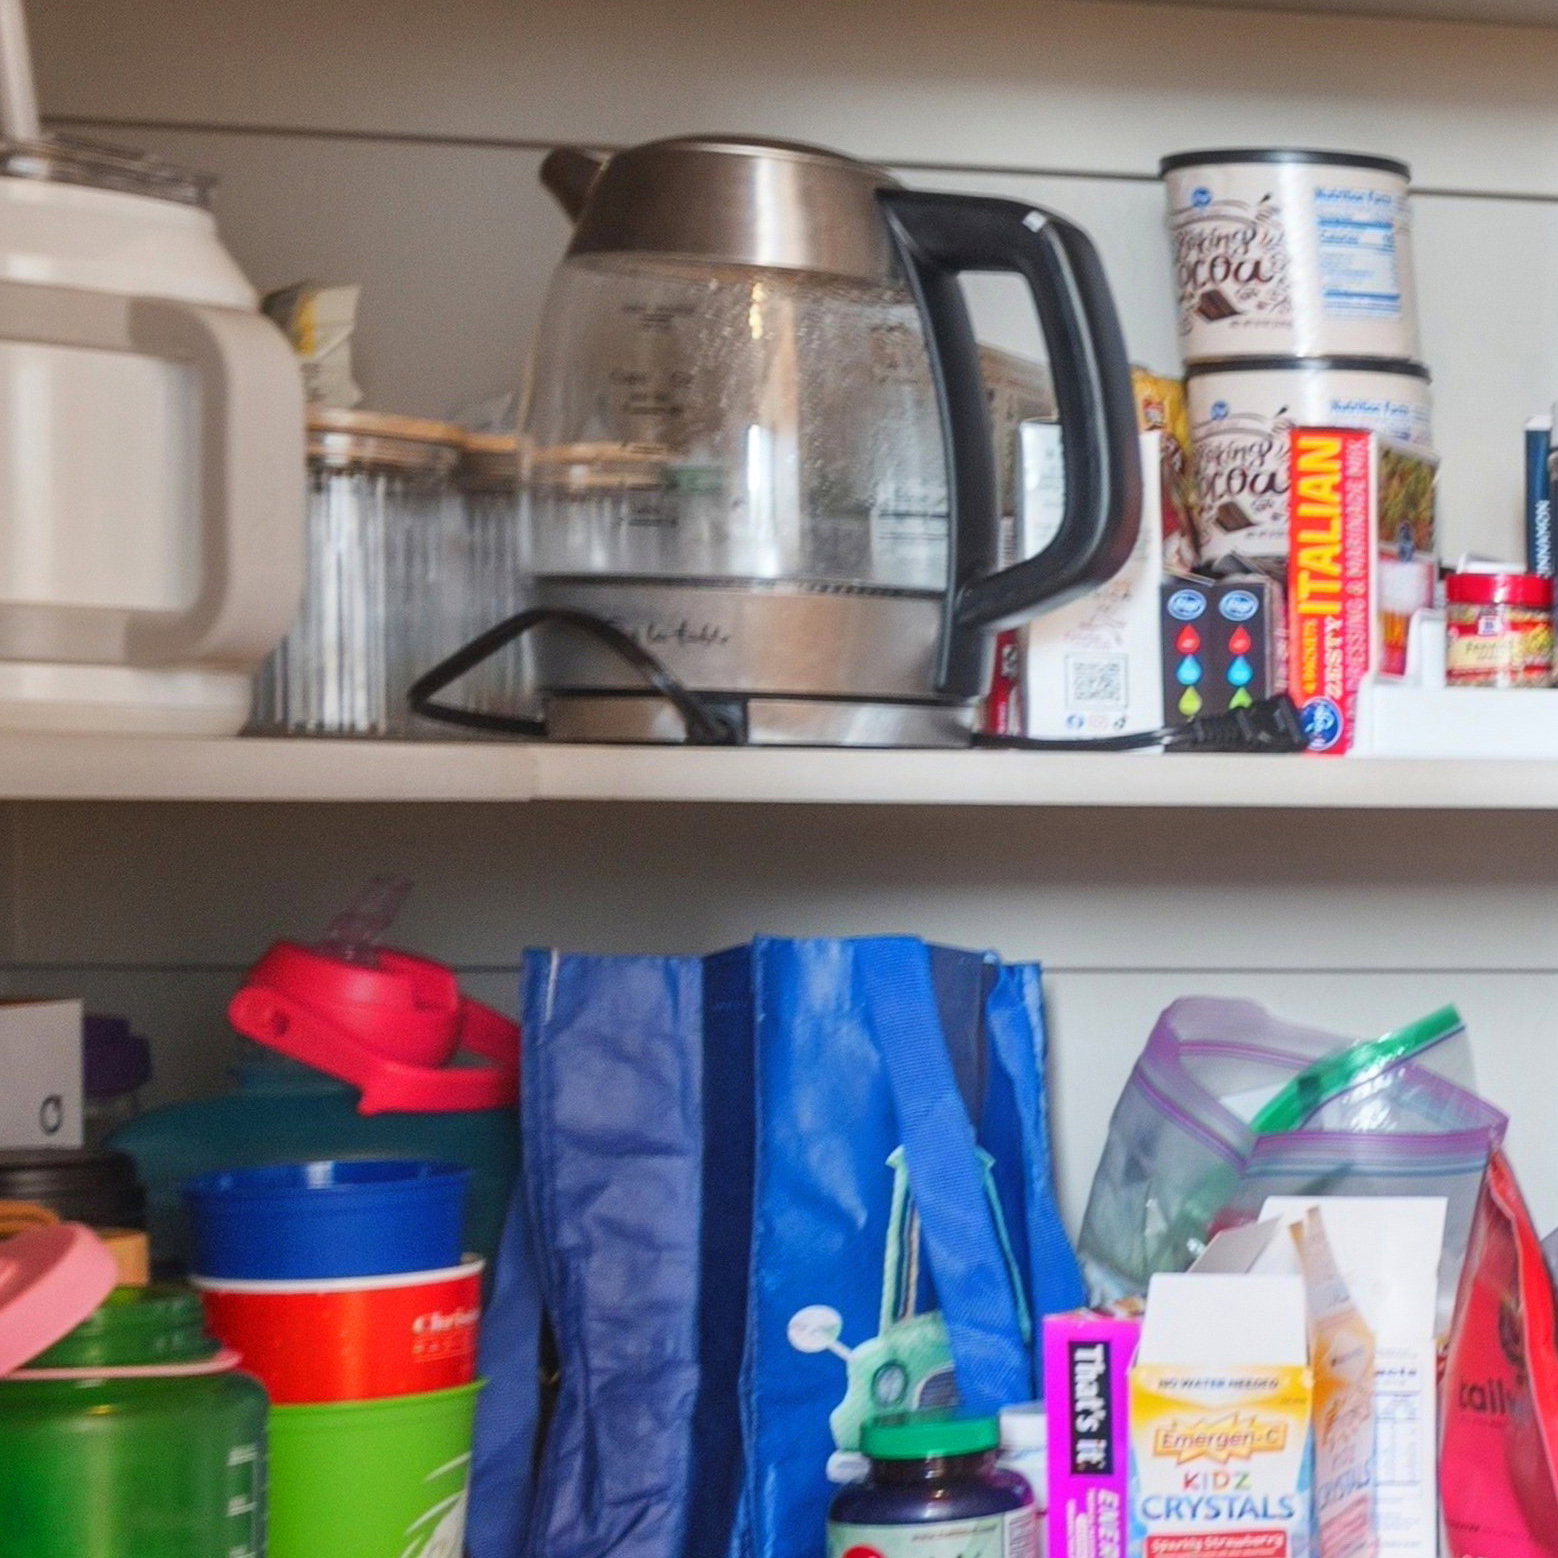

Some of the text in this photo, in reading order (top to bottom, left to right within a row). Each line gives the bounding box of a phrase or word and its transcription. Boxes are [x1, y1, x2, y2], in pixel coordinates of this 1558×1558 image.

[1297, 436, 1342, 616] ITALIAN
[1072, 1344, 1106, 1433] That's
[1175, 1377, 1225, 1390] WATER
[1161, 1423, 1278, 1450] Emergen-C
[1182, 1471, 1250, 1491] KIDZ
[1142, 1494, 1296, 1520] CRYSTALS
